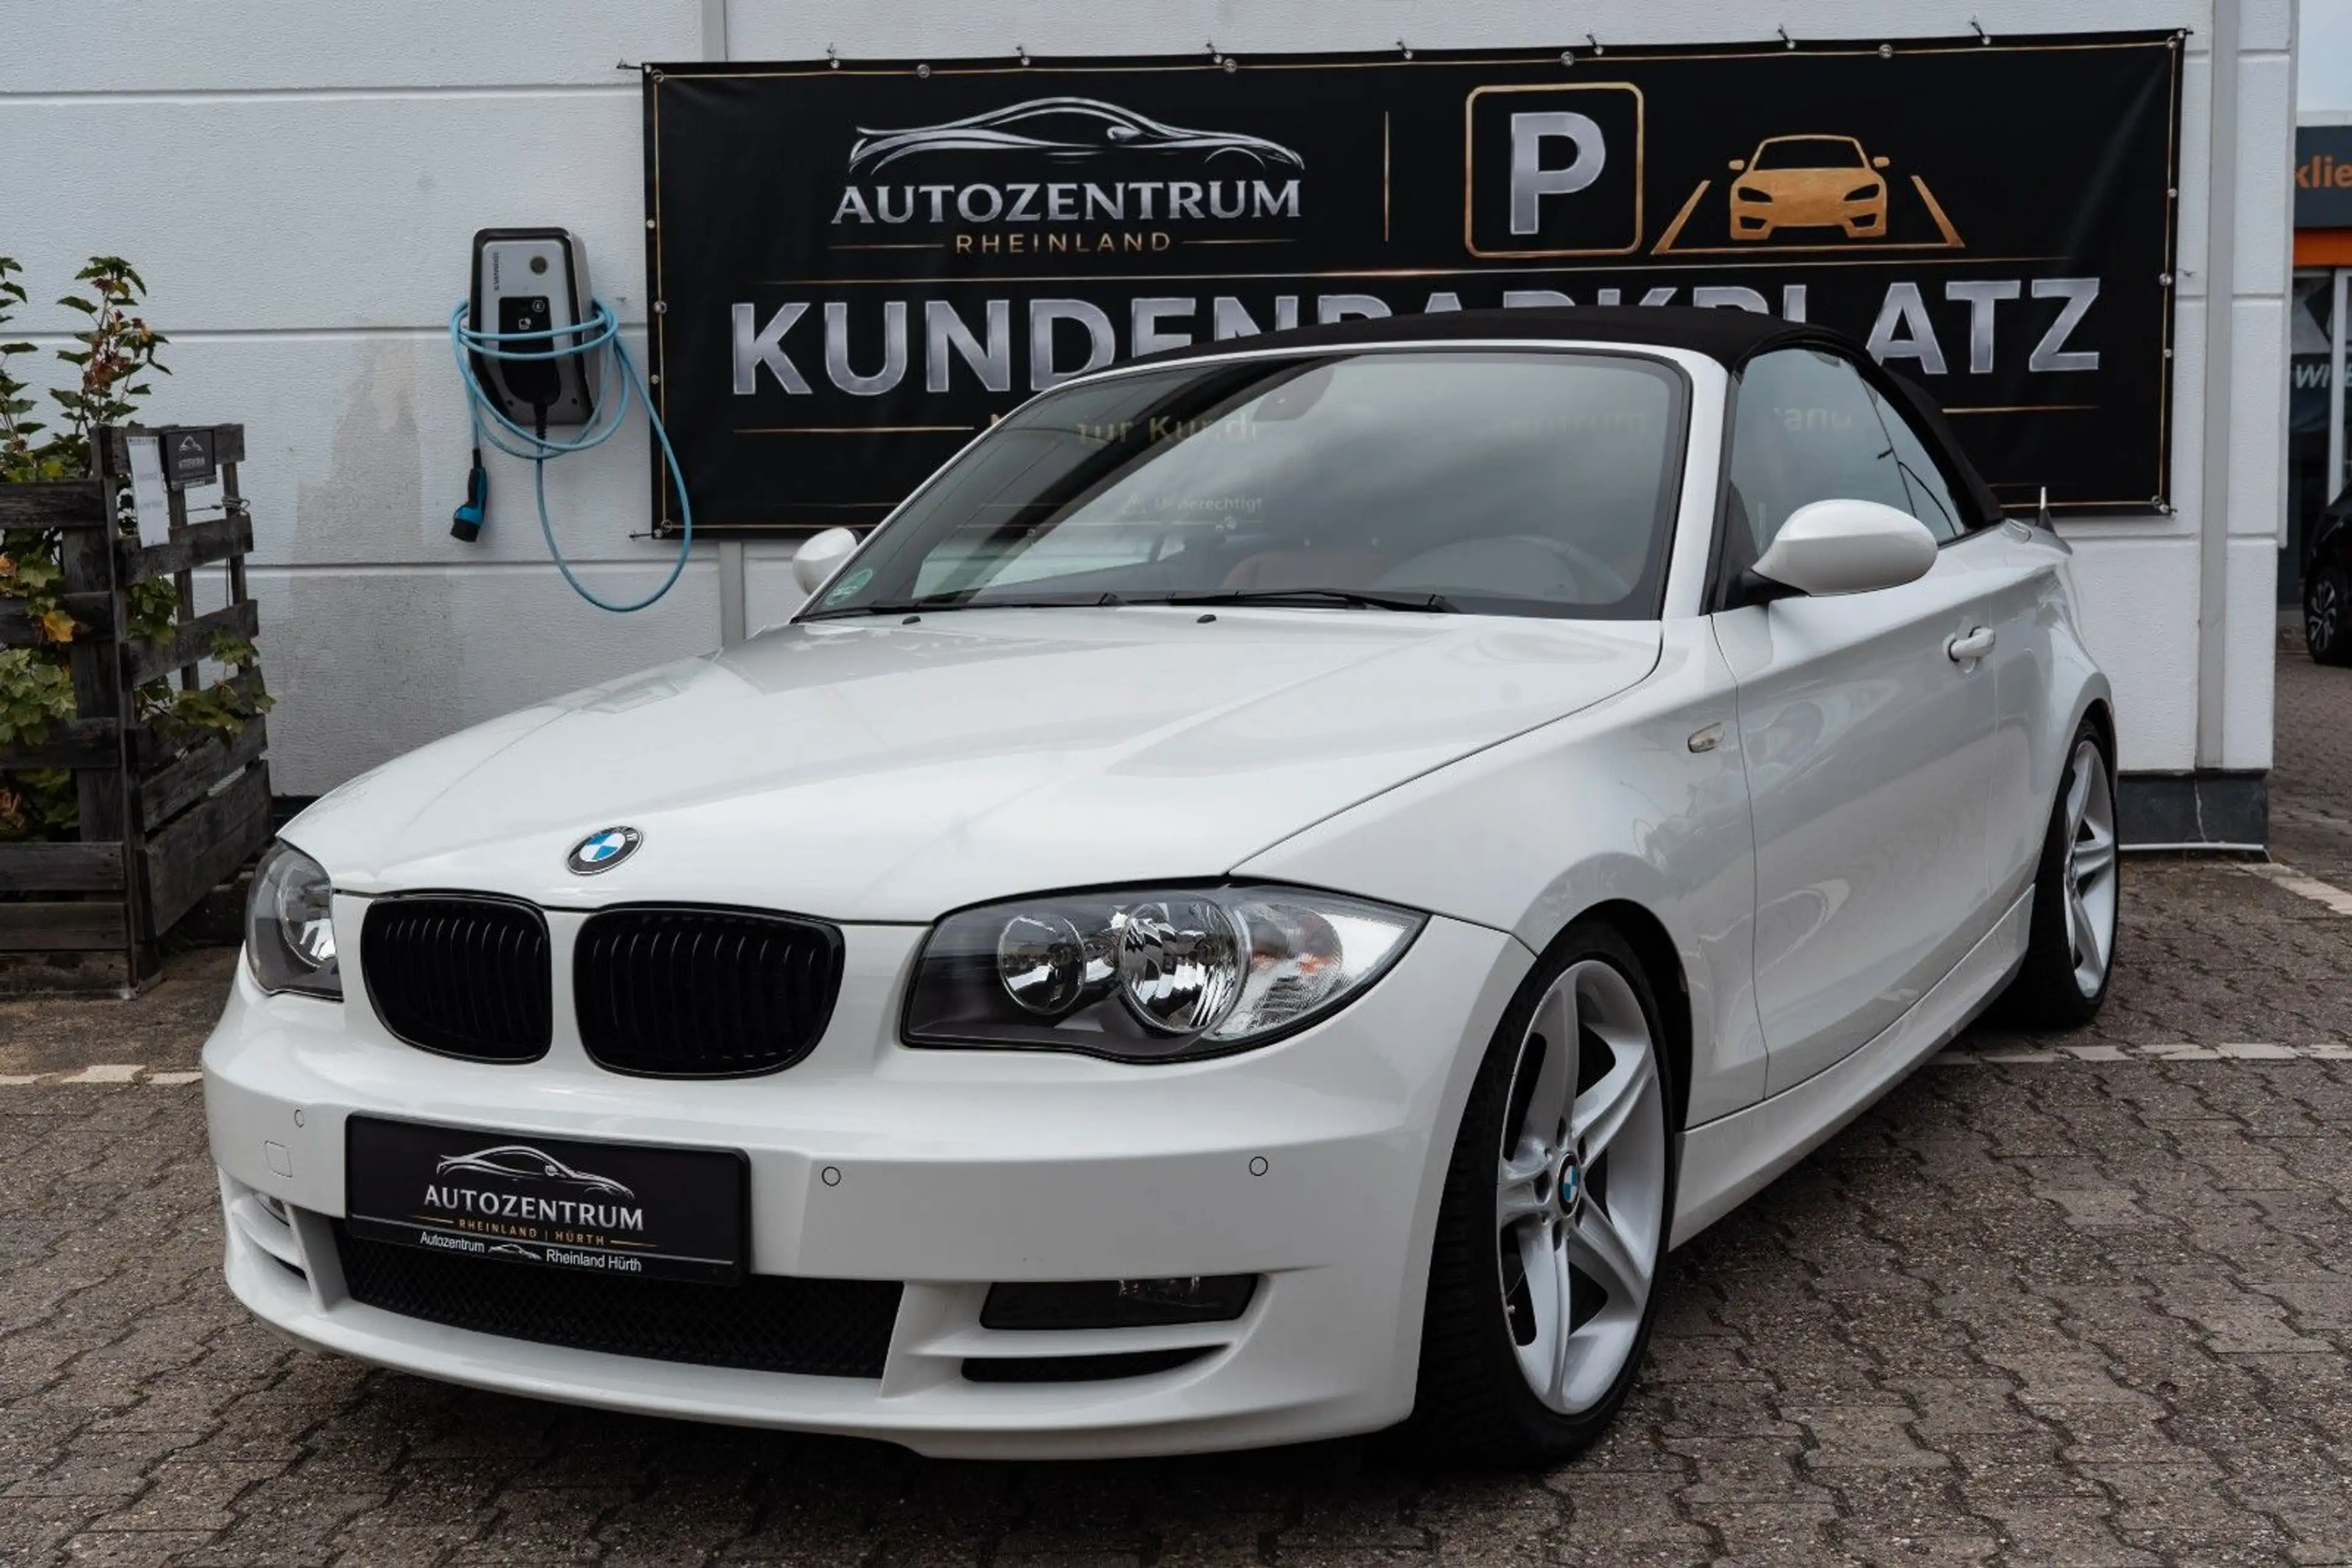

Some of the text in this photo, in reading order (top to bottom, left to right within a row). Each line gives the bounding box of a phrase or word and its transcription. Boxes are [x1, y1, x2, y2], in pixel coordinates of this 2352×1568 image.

[1510, 111, 1606, 235] P
[831, 179, 1302, 224] AUTOZENTRUM
[956, 232, 1170, 254] RHEINLAND
[423, 1184, 644, 1231] AUTOZENTRUM
[420, 1231, 642, 1272] Autozentrum Rheinland Hürth
[459, 1218, 605, 1246] RHEINLAND HÜRTH
